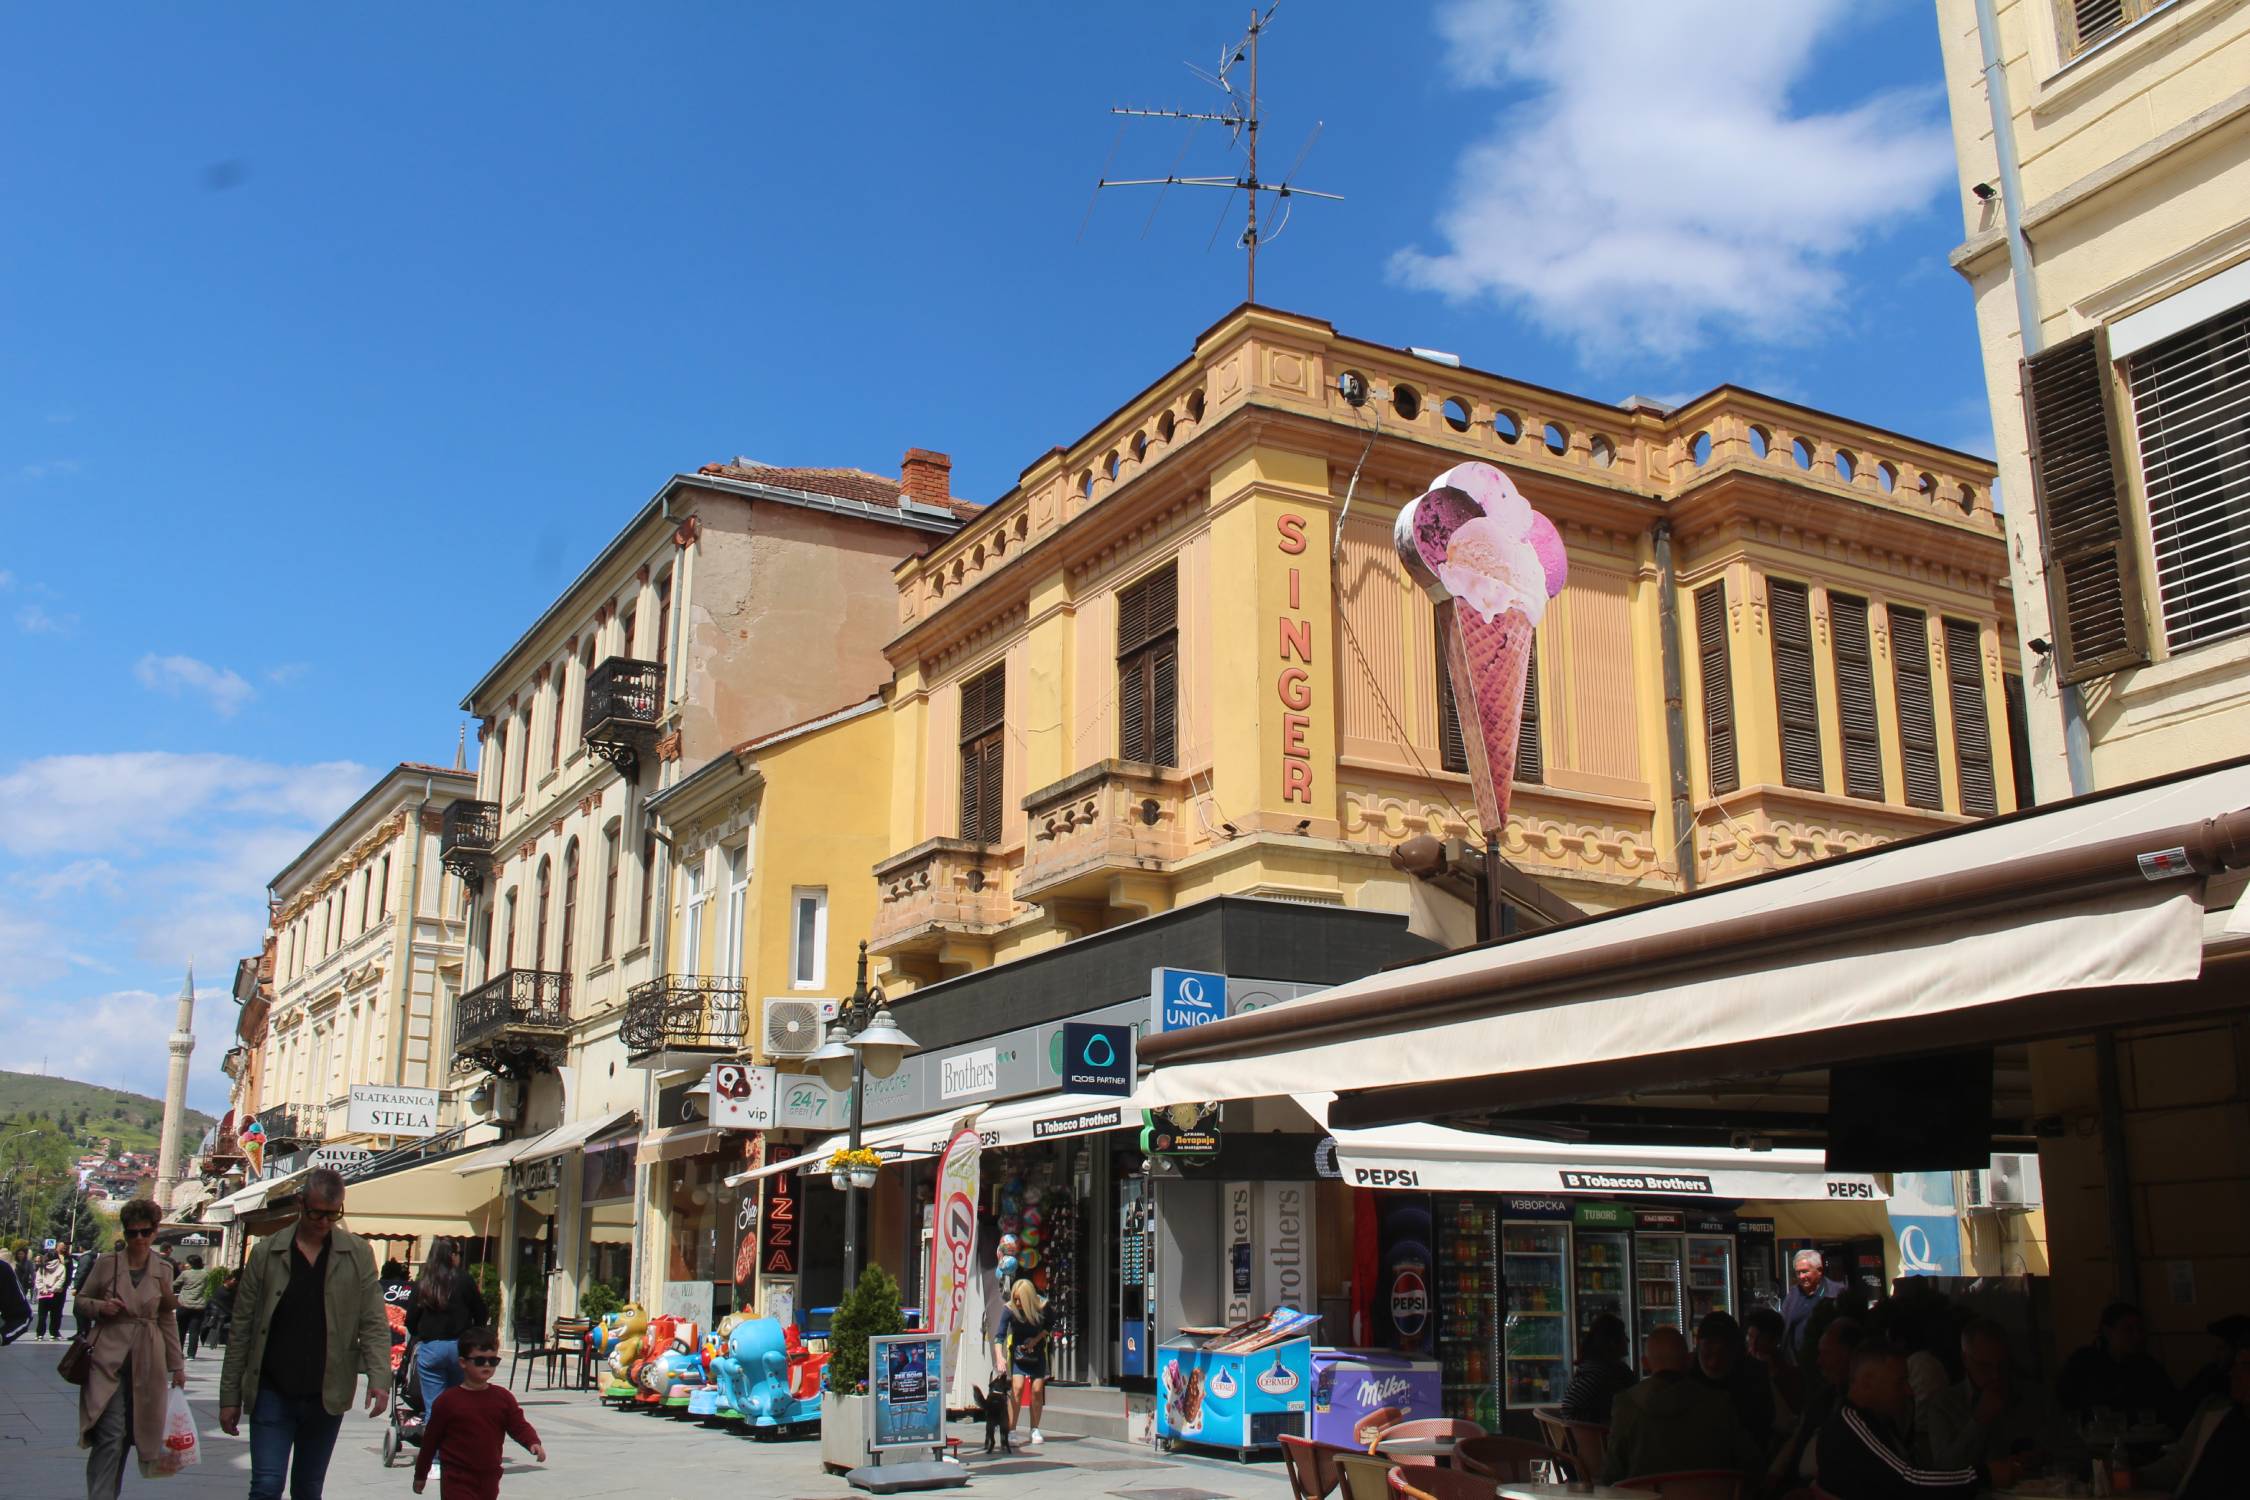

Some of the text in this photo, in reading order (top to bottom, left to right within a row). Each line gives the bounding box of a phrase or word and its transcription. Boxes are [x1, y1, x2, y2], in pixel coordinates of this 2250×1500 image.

[1277, 513, 1313, 805] SINGER
[944, 1057, 994, 1094] Brothers
[1071, 1075, 1126, 1085] IQOS PARTNER
[354, 1091, 435, 1106] SLATKARNICA
[370, 1110, 430, 1127] STELA
[747, 1107, 768, 1122] vip
[1036, 1113, 1118, 1135] B Tobacco Brothers
[980, 1131, 1000, 1146] EPSI
[1175, 1135, 1215, 1146] Лотарија
[316, 1150, 368, 1160] SILVER
[1355, 1168, 1420, 1187] PEPSI
[1566, 1174, 1707, 1191] B Tobacco Brothers
[1827, 1182, 1874, 1198] PEPSI
[1511, 1199, 1566, 1211] ИЗВОРСКА
[1583, 1208, 1617, 1221] TUBORG
[1270, 1189, 1301, 1312] rothers
[1393, 1296, 1425, 1310] PEPSI
[1356, 1375, 1408, 1408] Milka
